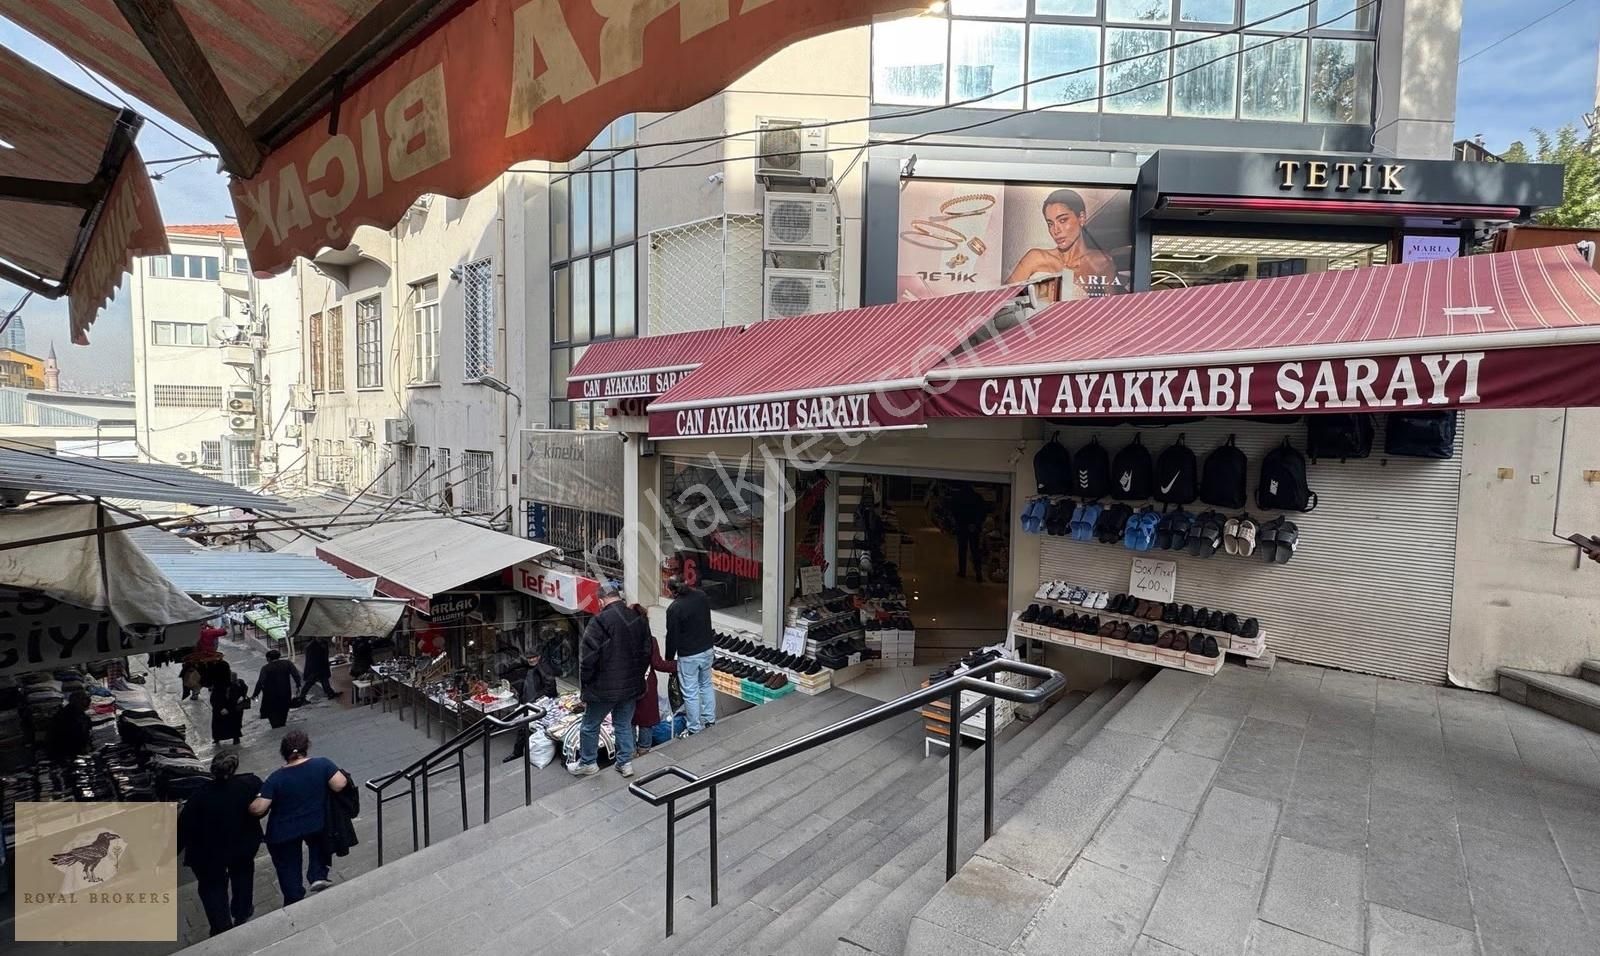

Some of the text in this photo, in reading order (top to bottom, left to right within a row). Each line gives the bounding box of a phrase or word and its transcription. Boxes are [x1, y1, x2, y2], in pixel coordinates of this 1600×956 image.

[1278, 158, 1406, 191] TETİK
[1076, 275, 1122, 286] ARLA
[583, 380, 601, 397] CAN
[604, 374, 651, 396] AYAKKABI
[979, 352, 1485, 416] CAN AYAKKABI SARAYI
[676, 394, 870, 436] CAN AYAKKABI SARAYI
[544, 442, 585, 461] kinetix
[430, 598, 473, 616] ARLAK
